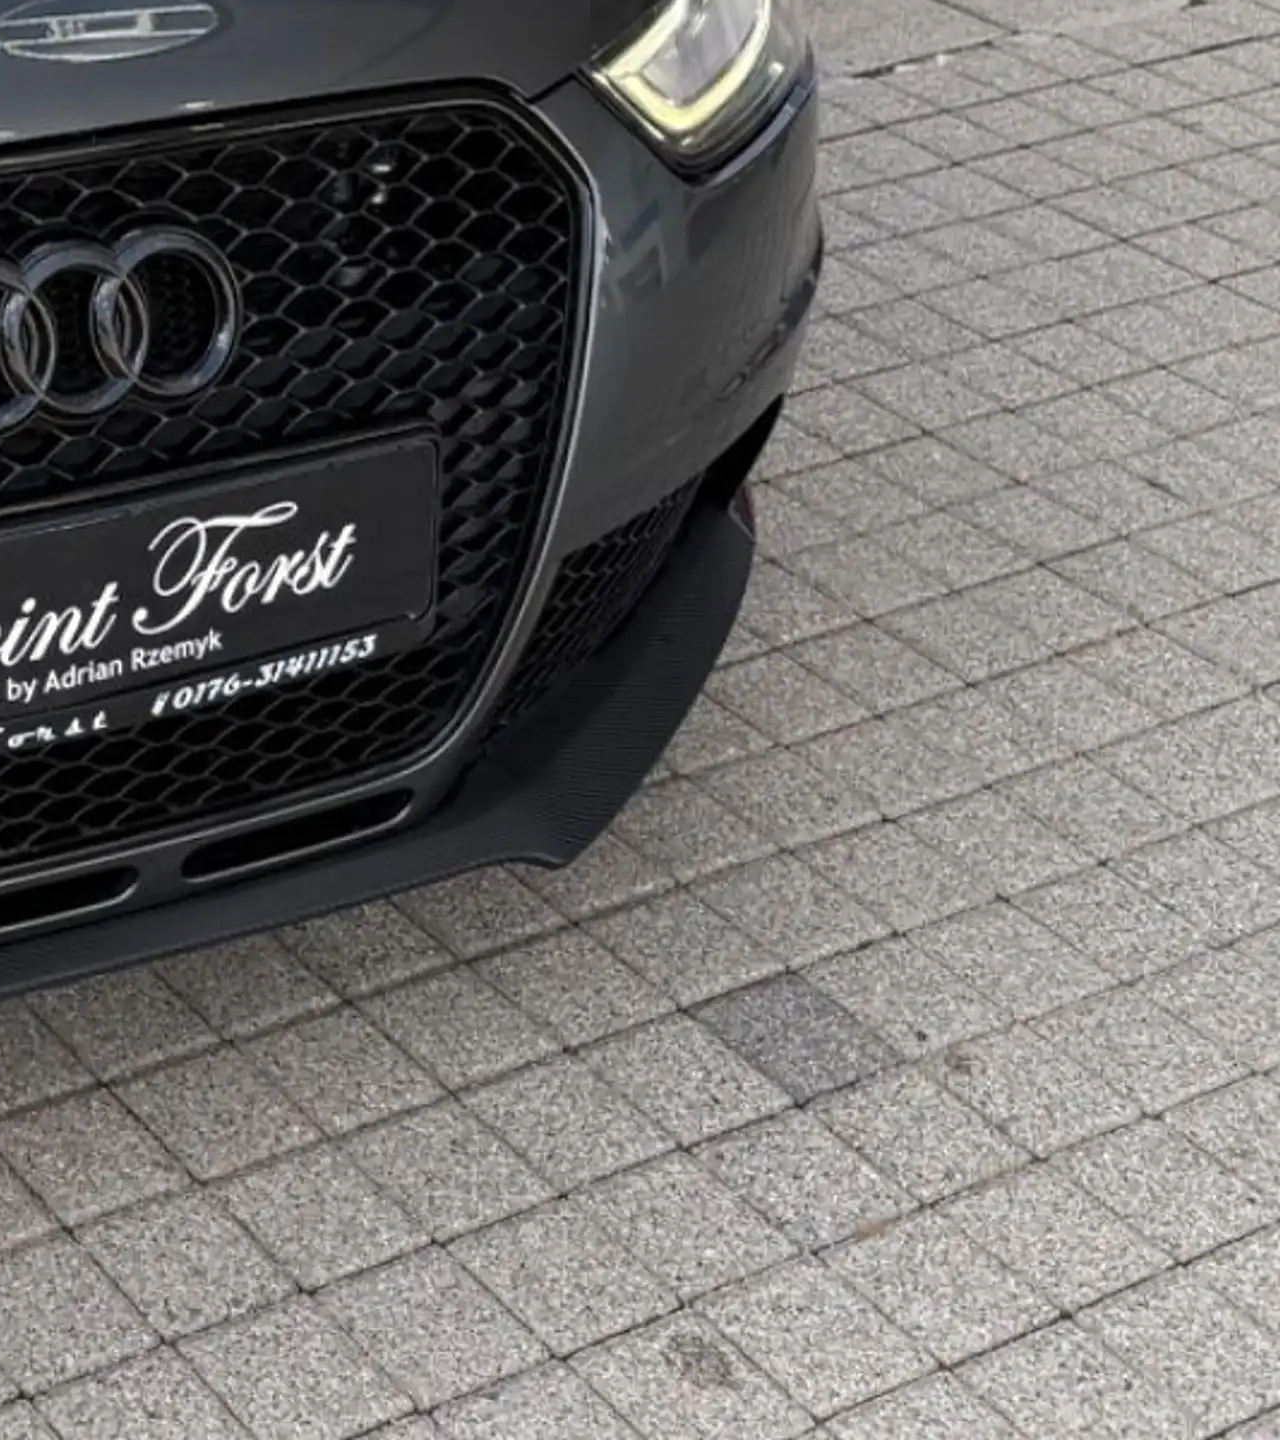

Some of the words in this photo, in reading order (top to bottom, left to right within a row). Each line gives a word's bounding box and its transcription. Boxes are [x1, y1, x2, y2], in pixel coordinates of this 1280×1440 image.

[131, 500, 355, 635] Forst
[6, 676, 37, 704] by
[43, 657, 123, 694] Adrian
[130, 627, 224, 672] Rzemyk
